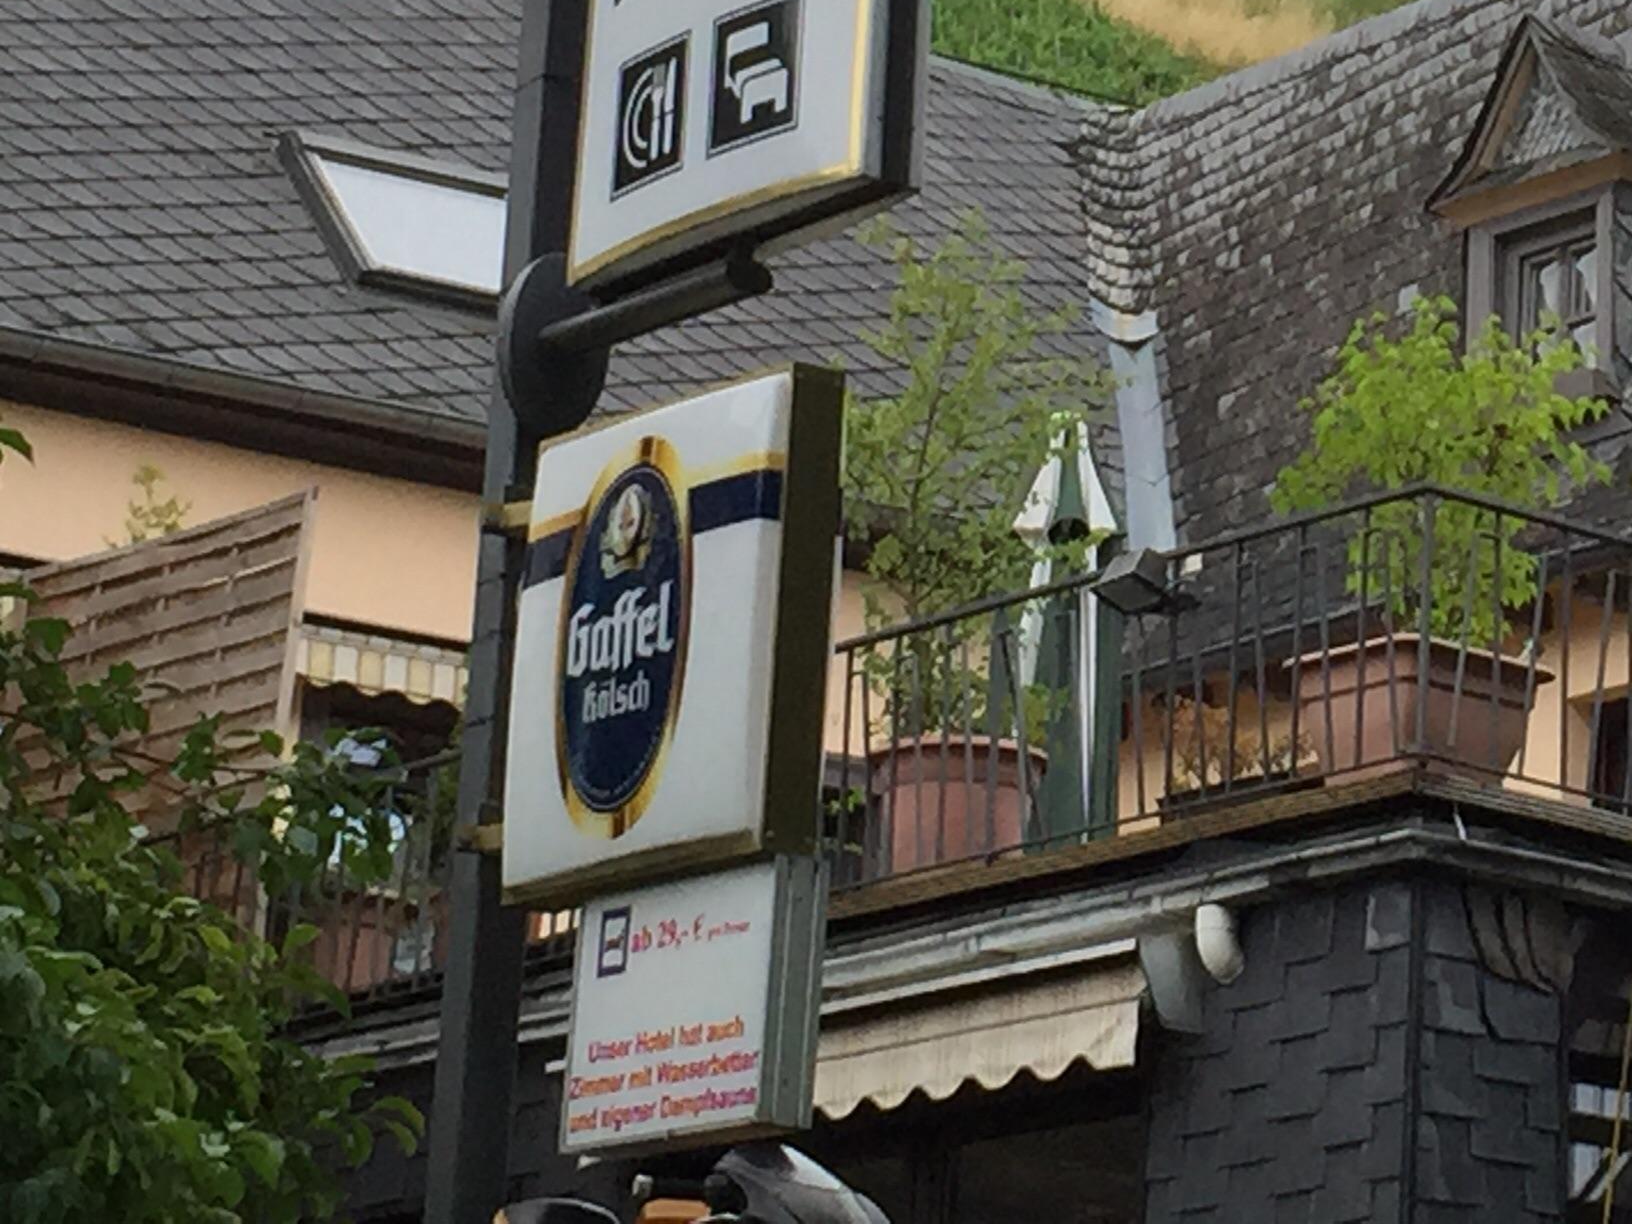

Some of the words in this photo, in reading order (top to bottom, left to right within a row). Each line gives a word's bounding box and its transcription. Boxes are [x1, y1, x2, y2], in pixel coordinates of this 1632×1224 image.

[567, 580, 675, 677] Gaffel
[581, 674, 651, 723] Kölsch
[631, 925, 652, 953] ab
[588, 1040, 632, 1063] Unser
[636, 1027, 674, 1054] Hotel
[680, 1023, 702, 1046] hat
[707, 1015, 744, 1042] auch
[569, 1074, 624, 1099] Zimmer
[629, 1065, 652, 1090] mit
[570, 1108, 597, 1133] und
